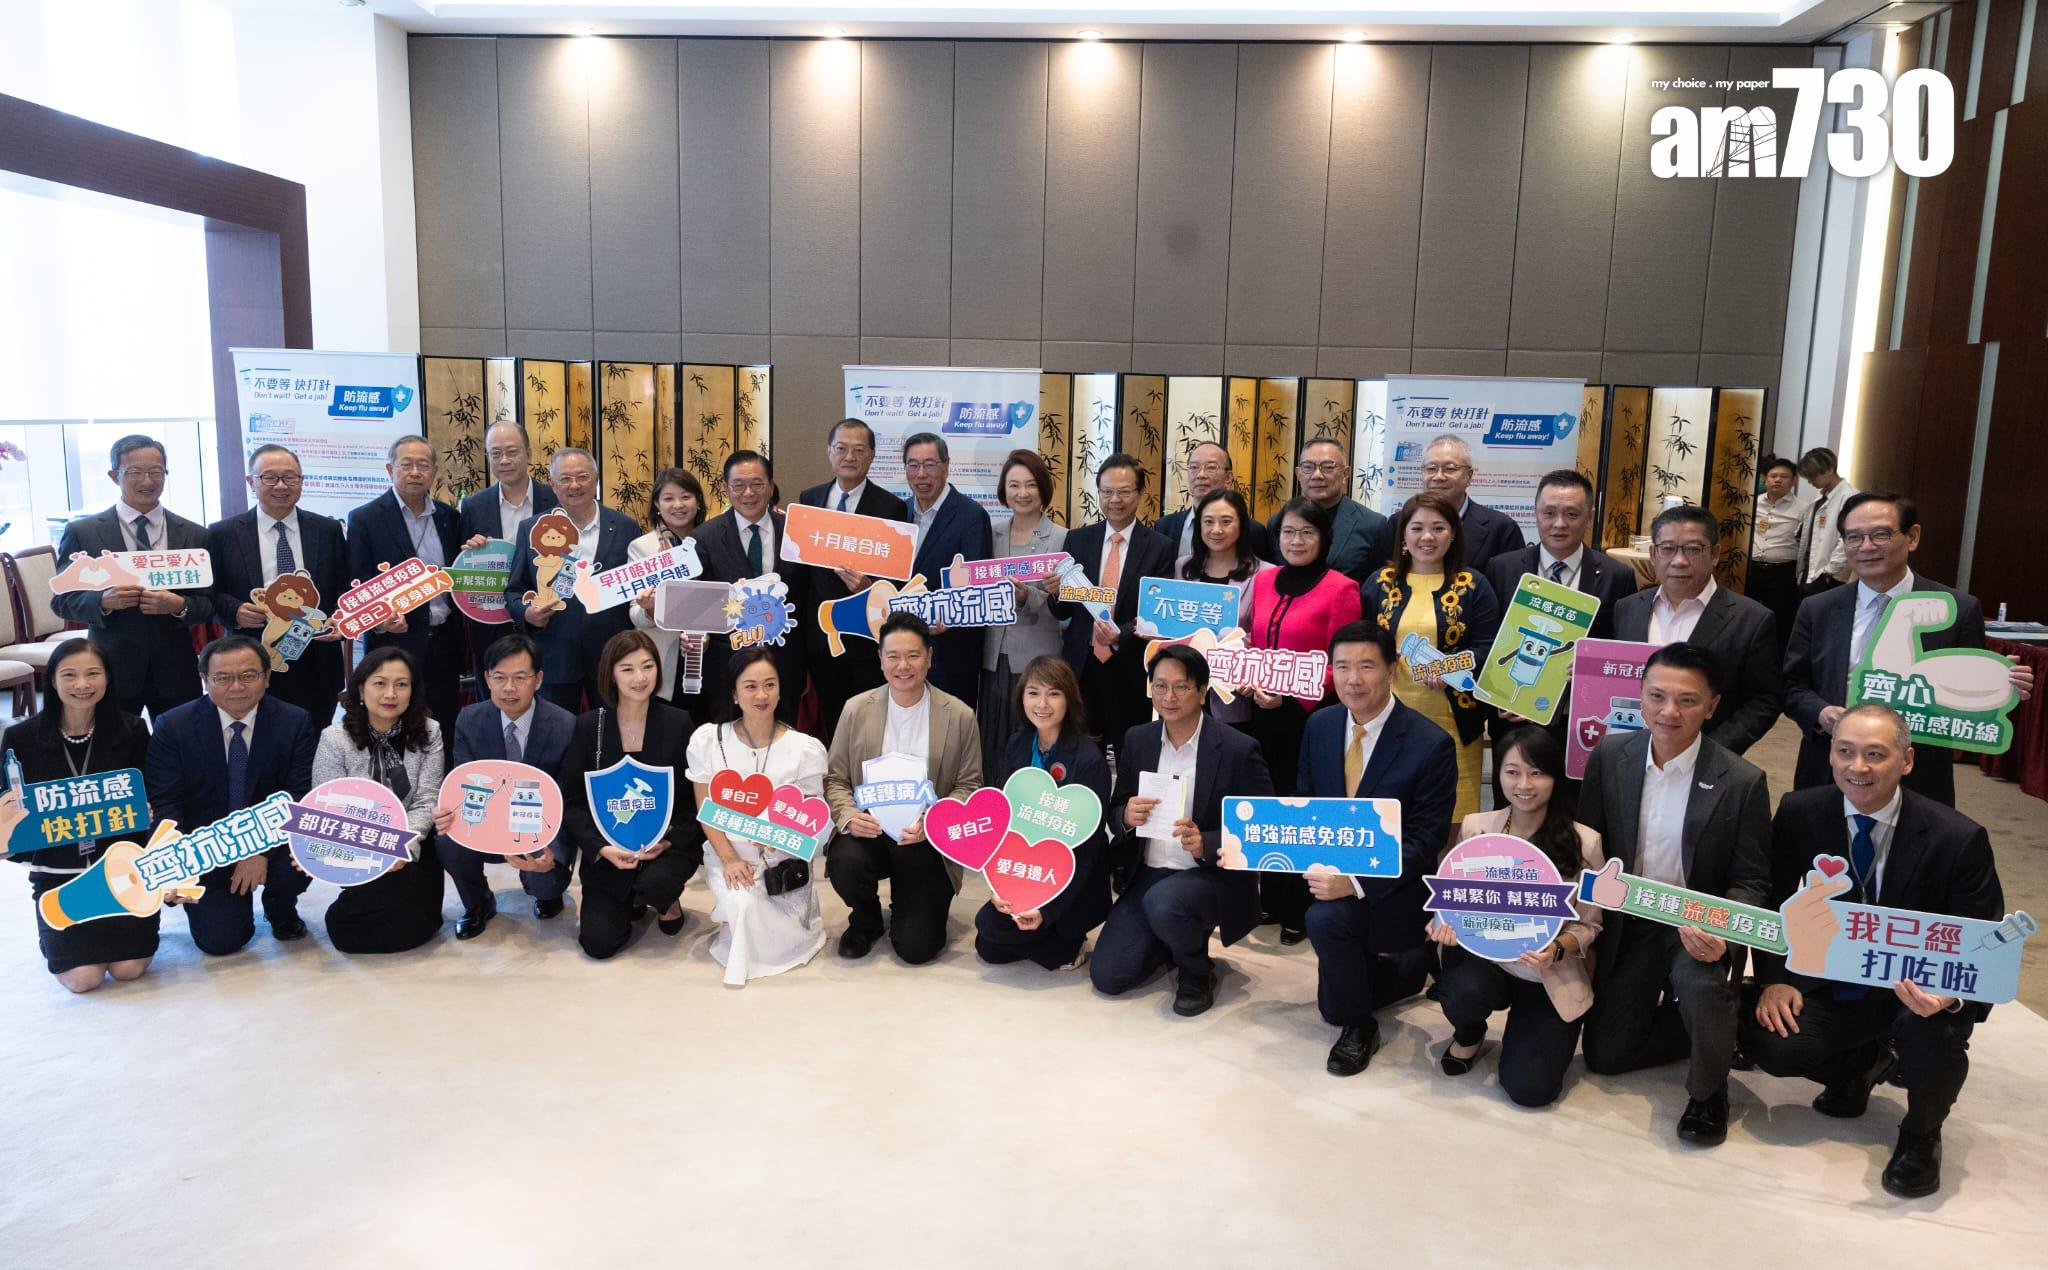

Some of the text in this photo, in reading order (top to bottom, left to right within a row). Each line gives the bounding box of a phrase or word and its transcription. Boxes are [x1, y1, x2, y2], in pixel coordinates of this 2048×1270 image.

[254, 377, 331, 392] 不要等 快打針
[339, 403, 358, 412] Keep
[369, 405, 390, 414] away!
[343, 390, 381, 404] 防流感
[866, 395, 946, 409] 不要等 快打針
[864, 409, 884, 417] Don't
[959, 407, 1000, 420] 防流感
[1405, 420, 1426, 428] Don't
[1406, 406, 1490, 420] 不要等 快打針
[1500, 418, 1543, 432] 防流感
[954, 421, 1008, 430] Keep flu away!
[1494, 432, 1515, 441] Keep
[1527, 433, 1550, 442] away!
[809, 530, 891, 559] 十月最合時
[132, 554, 200, 570] 愛己愛人
[599, 552, 674, 587] 早打唔好遲
[148, 569, 201, 587] 快打針
[342, 562, 423, 610] 接種流感疫苗
[394, 576, 450, 610] 愛身邊人
[1060, 585, 1116, 603] 流感疫苗
[345, 604, 391, 635] 愛自己
[1153, 597, 1224, 626] 不要等
[1529, 596, 1578, 622] 流感疫苗
[731, 625, 765, 650] FLU
[1206, 649, 1326, 697] 齊抗流感
[1412, 654, 1474, 681] 流感疫苗
[1862, 672, 1932, 709] 齊心
[1896, 709, 1999, 744] 流感防線
[34, 774, 135, 813] 防流感
[607, 797, 656, 812] 流感疫苗
[721, 788, 760, 805] 愛自己
[857, 780, 934, 805] 保護病人
[1038, 791, 1072, 815] 接種
[41, 803, 138, 844] 快打針
[344, 803, 392, 826] 流感疫苗
[772, 801, 818, 833] 愛身邊人
[1017, 804, 1079, 838] 流感疫苗
[712, 808, 805, 851] 接種流感疫苗
[947, 817, 994, 841] 愛自己
[1244, 824, 1375, 849] 增強流感免疫力
[137, 794, 292, 891] 齊抗流感
[307, 842, 355, 863] 新冠疫苗
[997, 858, 1058, 886] 愛身邊人
[1485, 866, 1539, 882] 流感疫苗
[1442, 887, 1558, 908] #幫緊你 幫緊你
[1462, 915, 1516, 932] 新冠疫苗
[1634, 886, 1782, 944] 接種流感疫苗
[1845, 910, 1964, 956] 我已經
